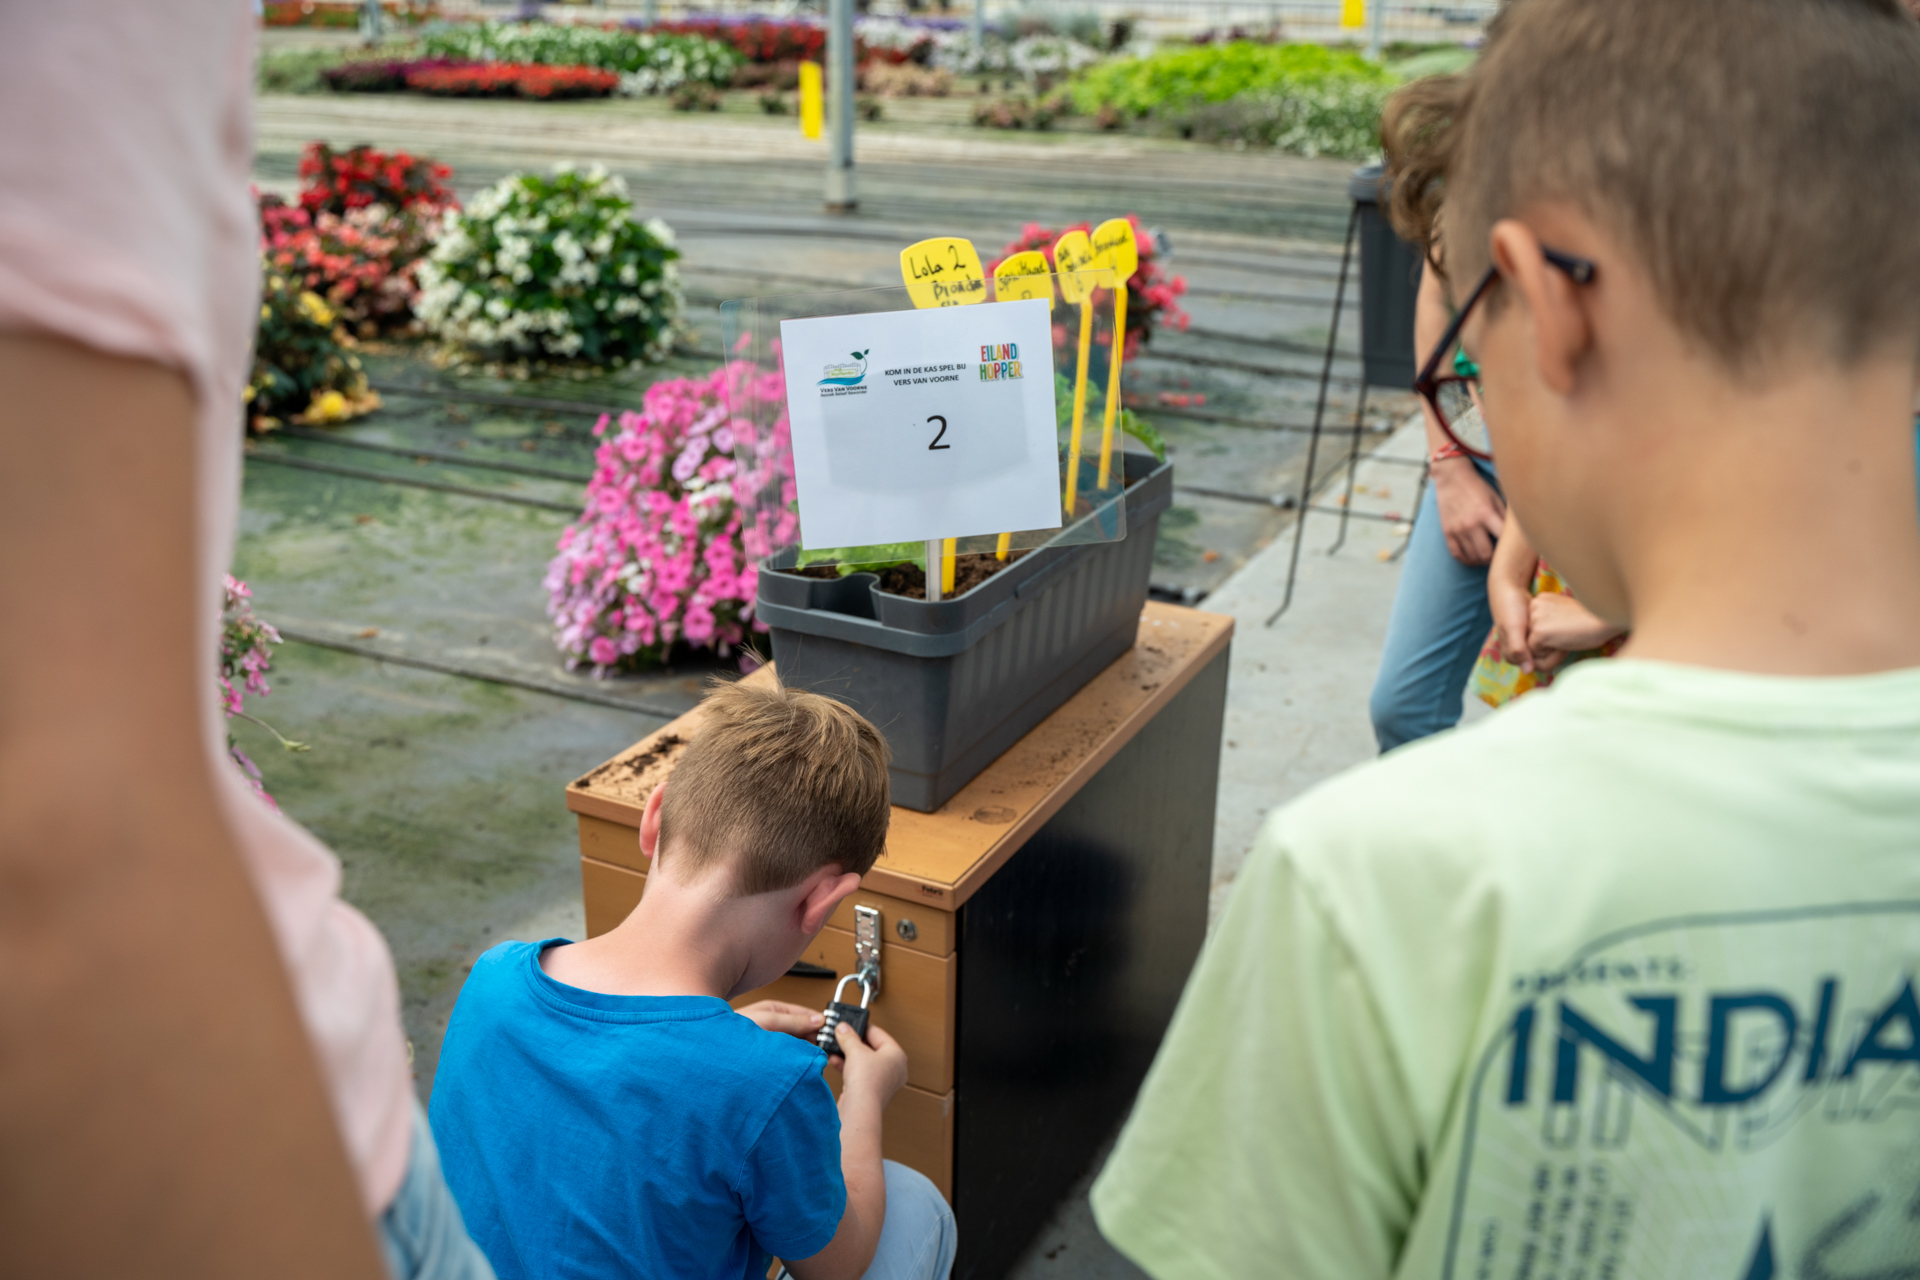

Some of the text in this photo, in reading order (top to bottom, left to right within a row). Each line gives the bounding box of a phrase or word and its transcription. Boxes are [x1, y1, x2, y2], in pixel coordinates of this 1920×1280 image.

[909, 244, 966, 279] Lola 2
[980, 343, 1018, 362] EILAND
[923, 365, 938, 373] KAS
[939, 364, 955, 372] SPEL
[979, 361, 1022, 381] HOPPER
[893, 374, 959, 386] VERS VAN VOORNE
[926, 415, 950, 450] 2
